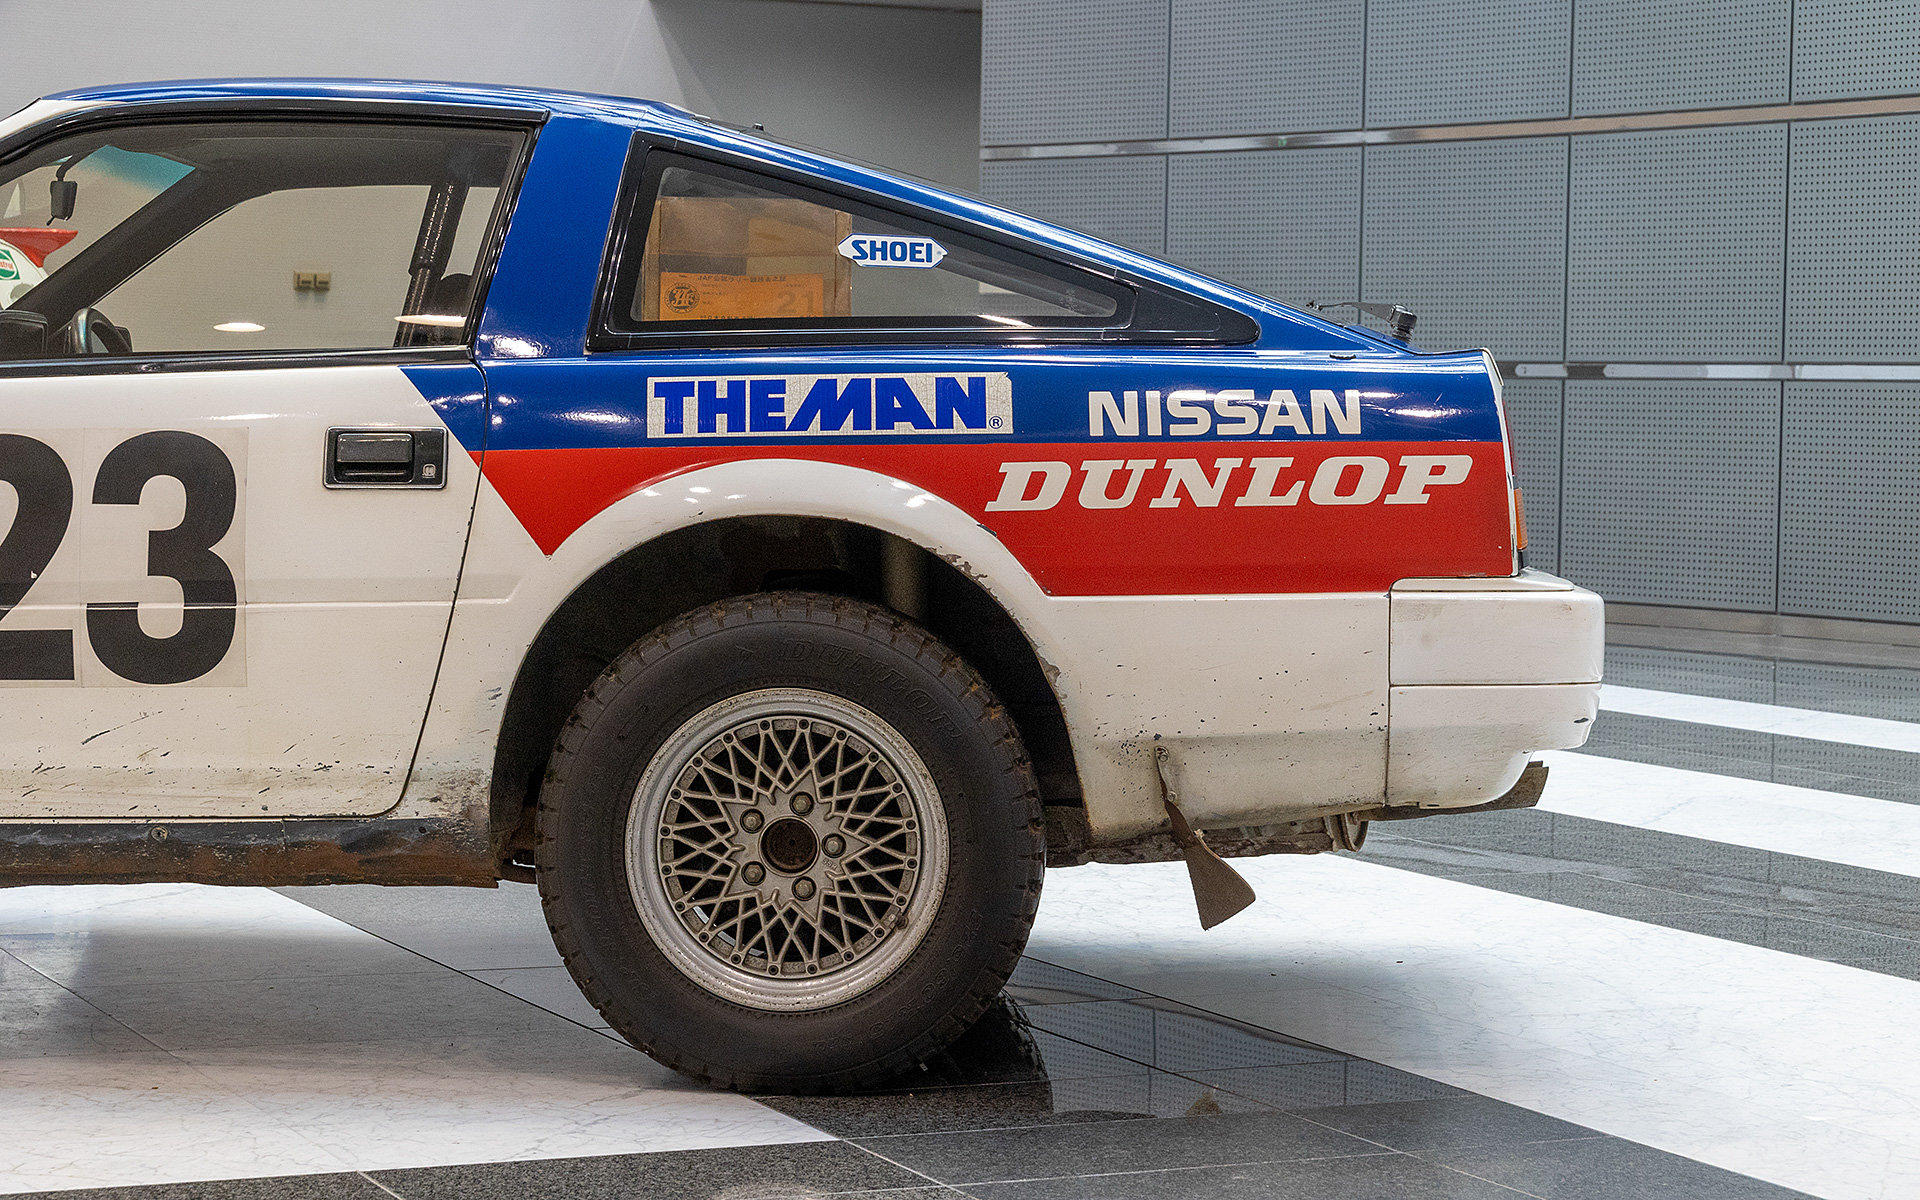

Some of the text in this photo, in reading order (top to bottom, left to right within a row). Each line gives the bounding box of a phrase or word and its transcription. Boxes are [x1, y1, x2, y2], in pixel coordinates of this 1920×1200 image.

[852, 239, 932, 263] SHOEI
[1088, 389, 1361, 437] NISSAN
[984, 454, 1473, 512] DUNLOP
[778, 639, 962, 738] DUNLOP
